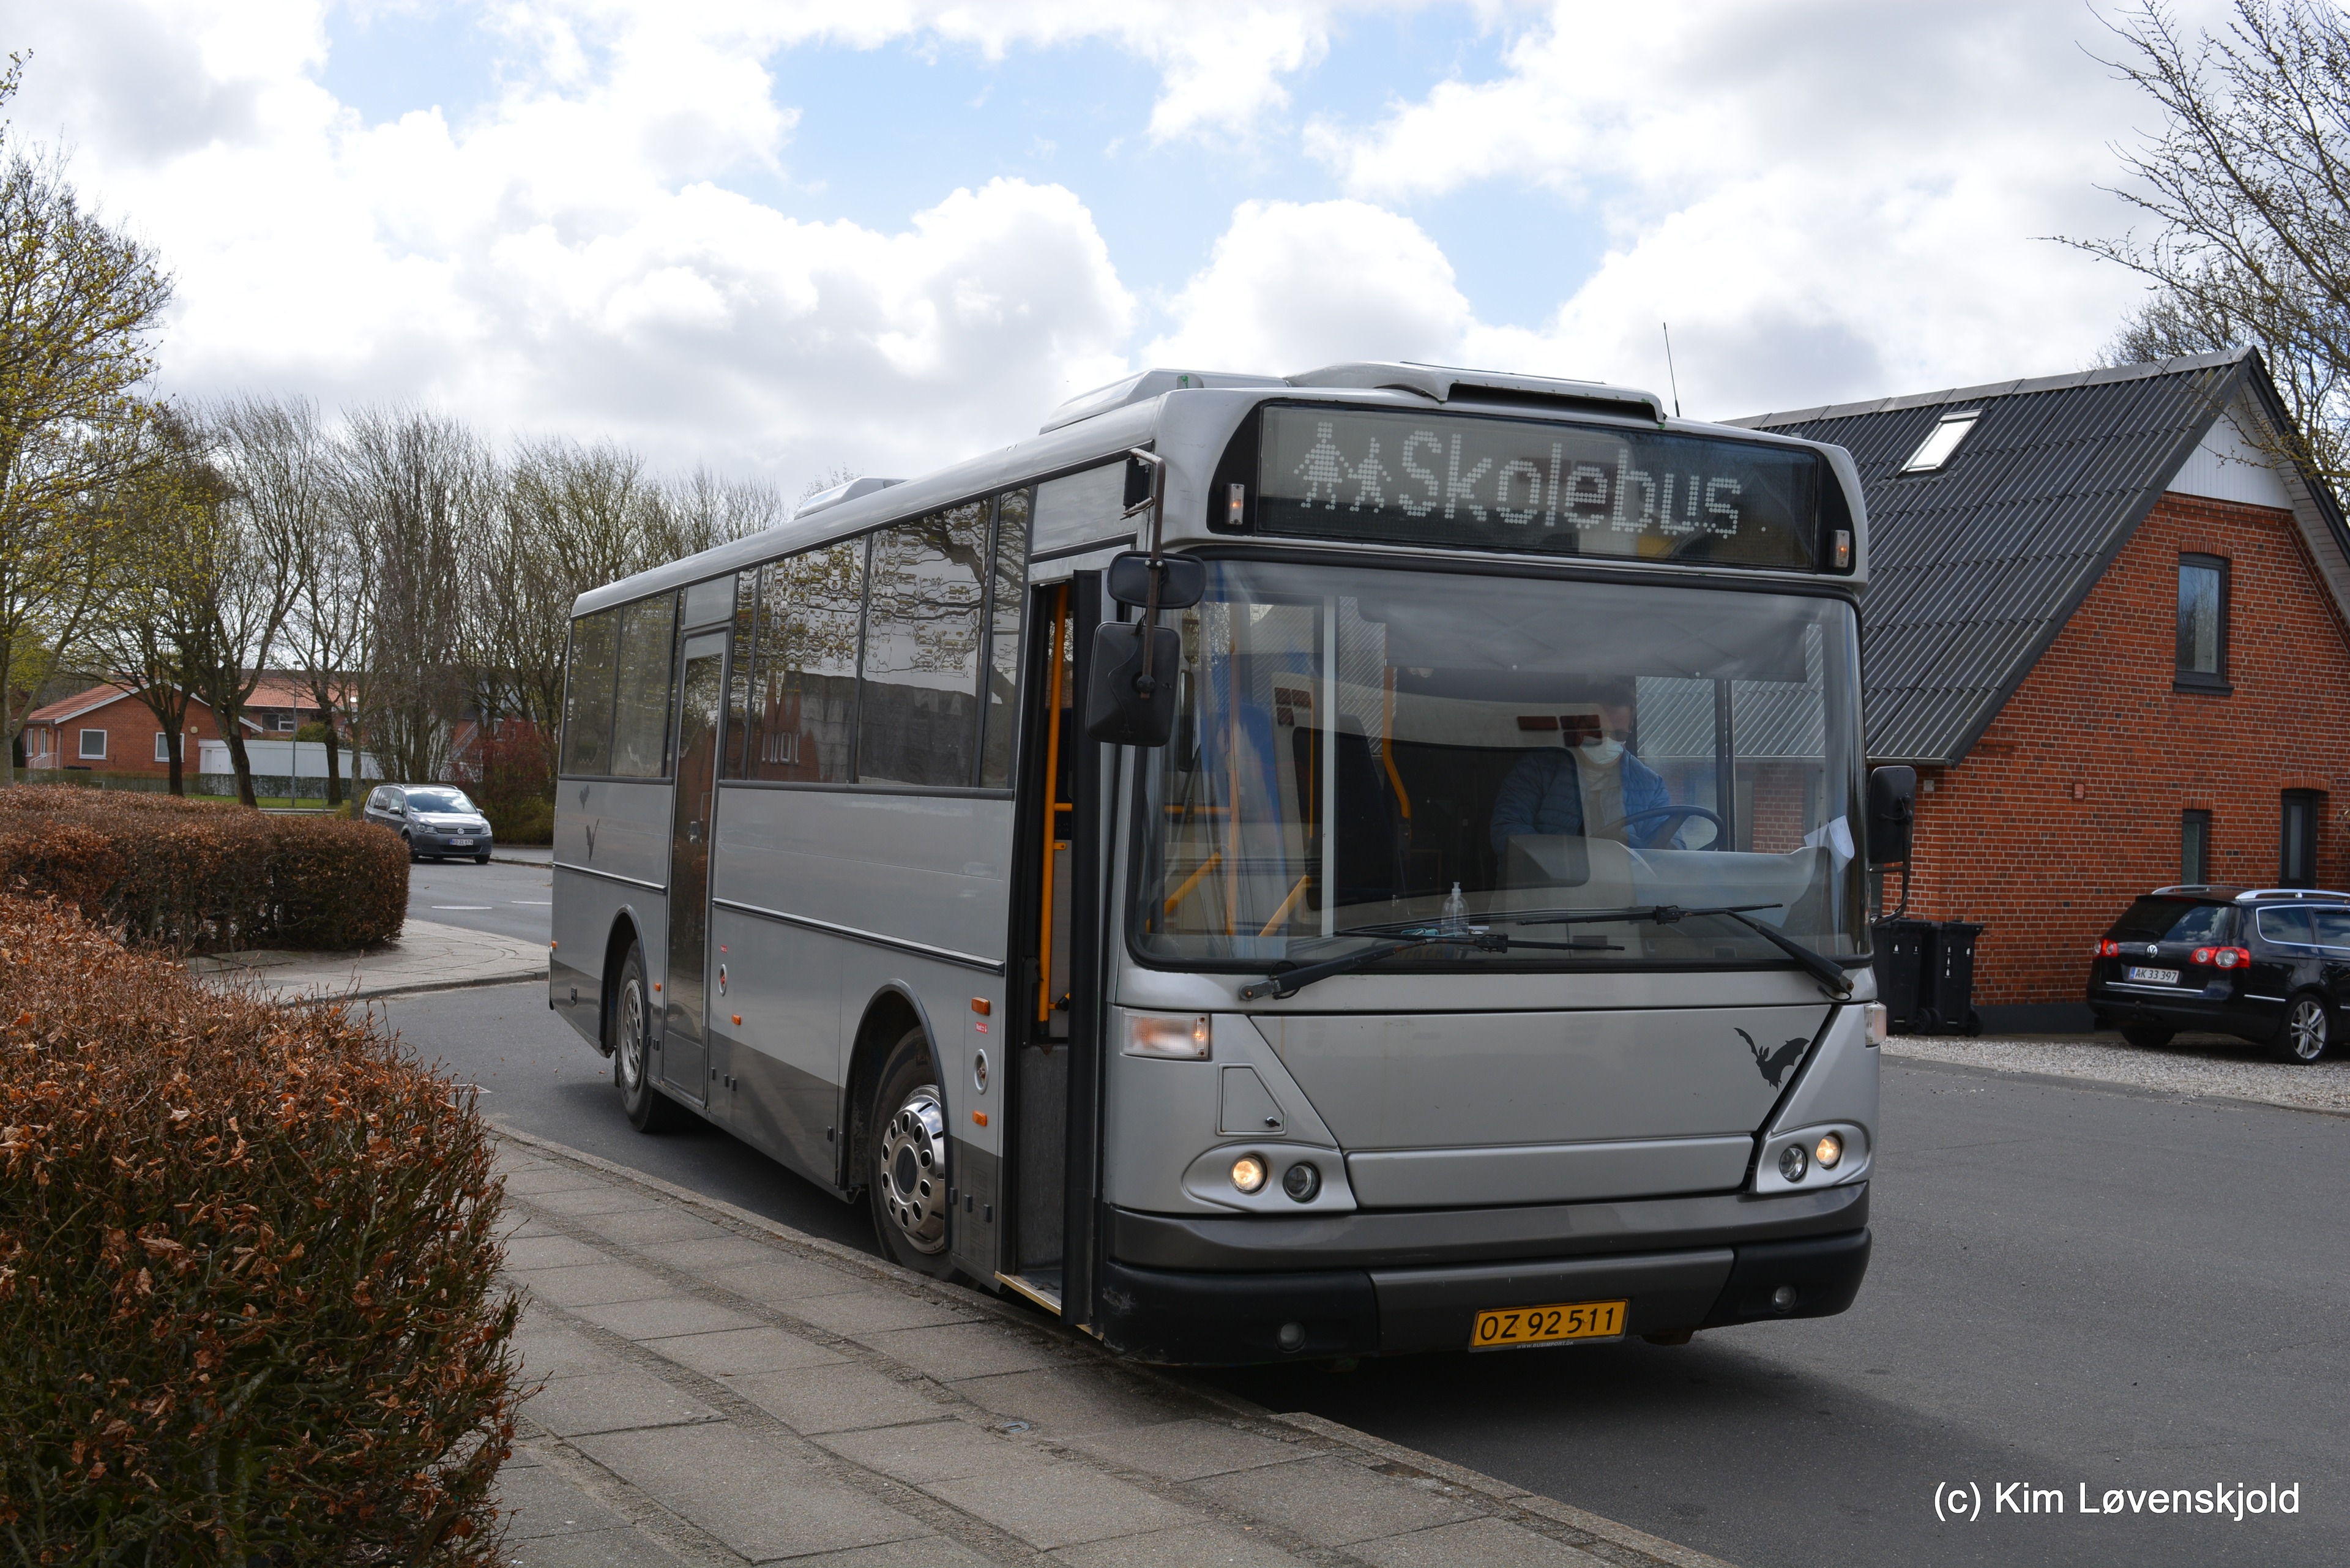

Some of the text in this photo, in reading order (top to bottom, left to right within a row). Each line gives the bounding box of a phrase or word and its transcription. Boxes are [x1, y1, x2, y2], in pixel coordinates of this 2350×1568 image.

[1399, 430, 1741, 539] Skolebus
[2135, 969, 2177, 981] AK 33 397
[1480, 1314, 1520, 1341] OZ
[1516, 1341, 1573, 1350] WWW.BUSIMPORT.DK
